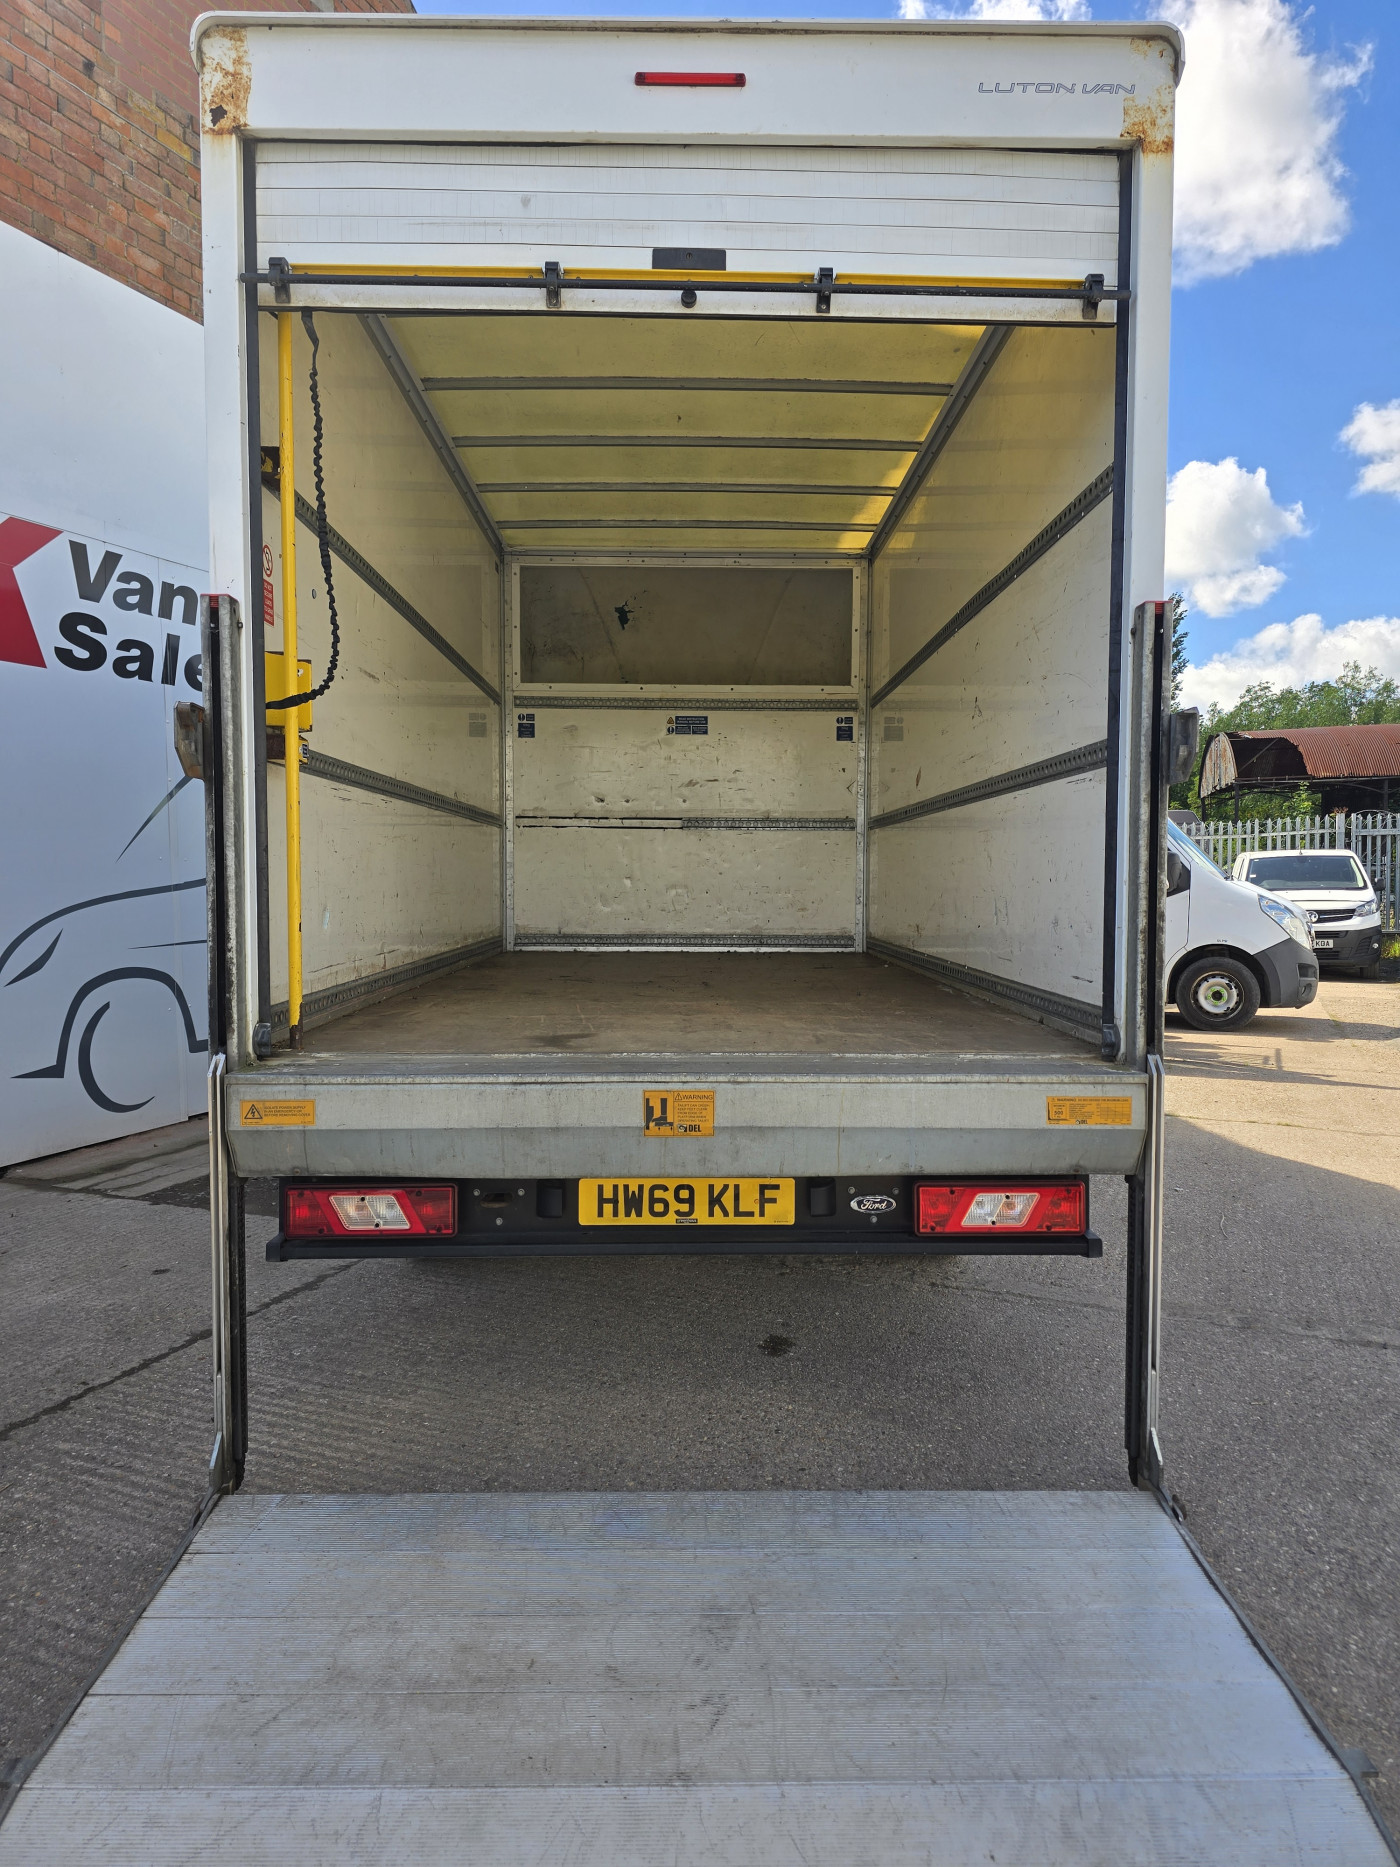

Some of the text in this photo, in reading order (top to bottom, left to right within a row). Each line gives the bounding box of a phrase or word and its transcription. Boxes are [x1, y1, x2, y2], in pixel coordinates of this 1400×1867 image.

[978, 82, 1136, 95] LUTON VAN
[68, 539, 199, 626] Van
[597, 1184, 781, 1218] HW69 KLF
